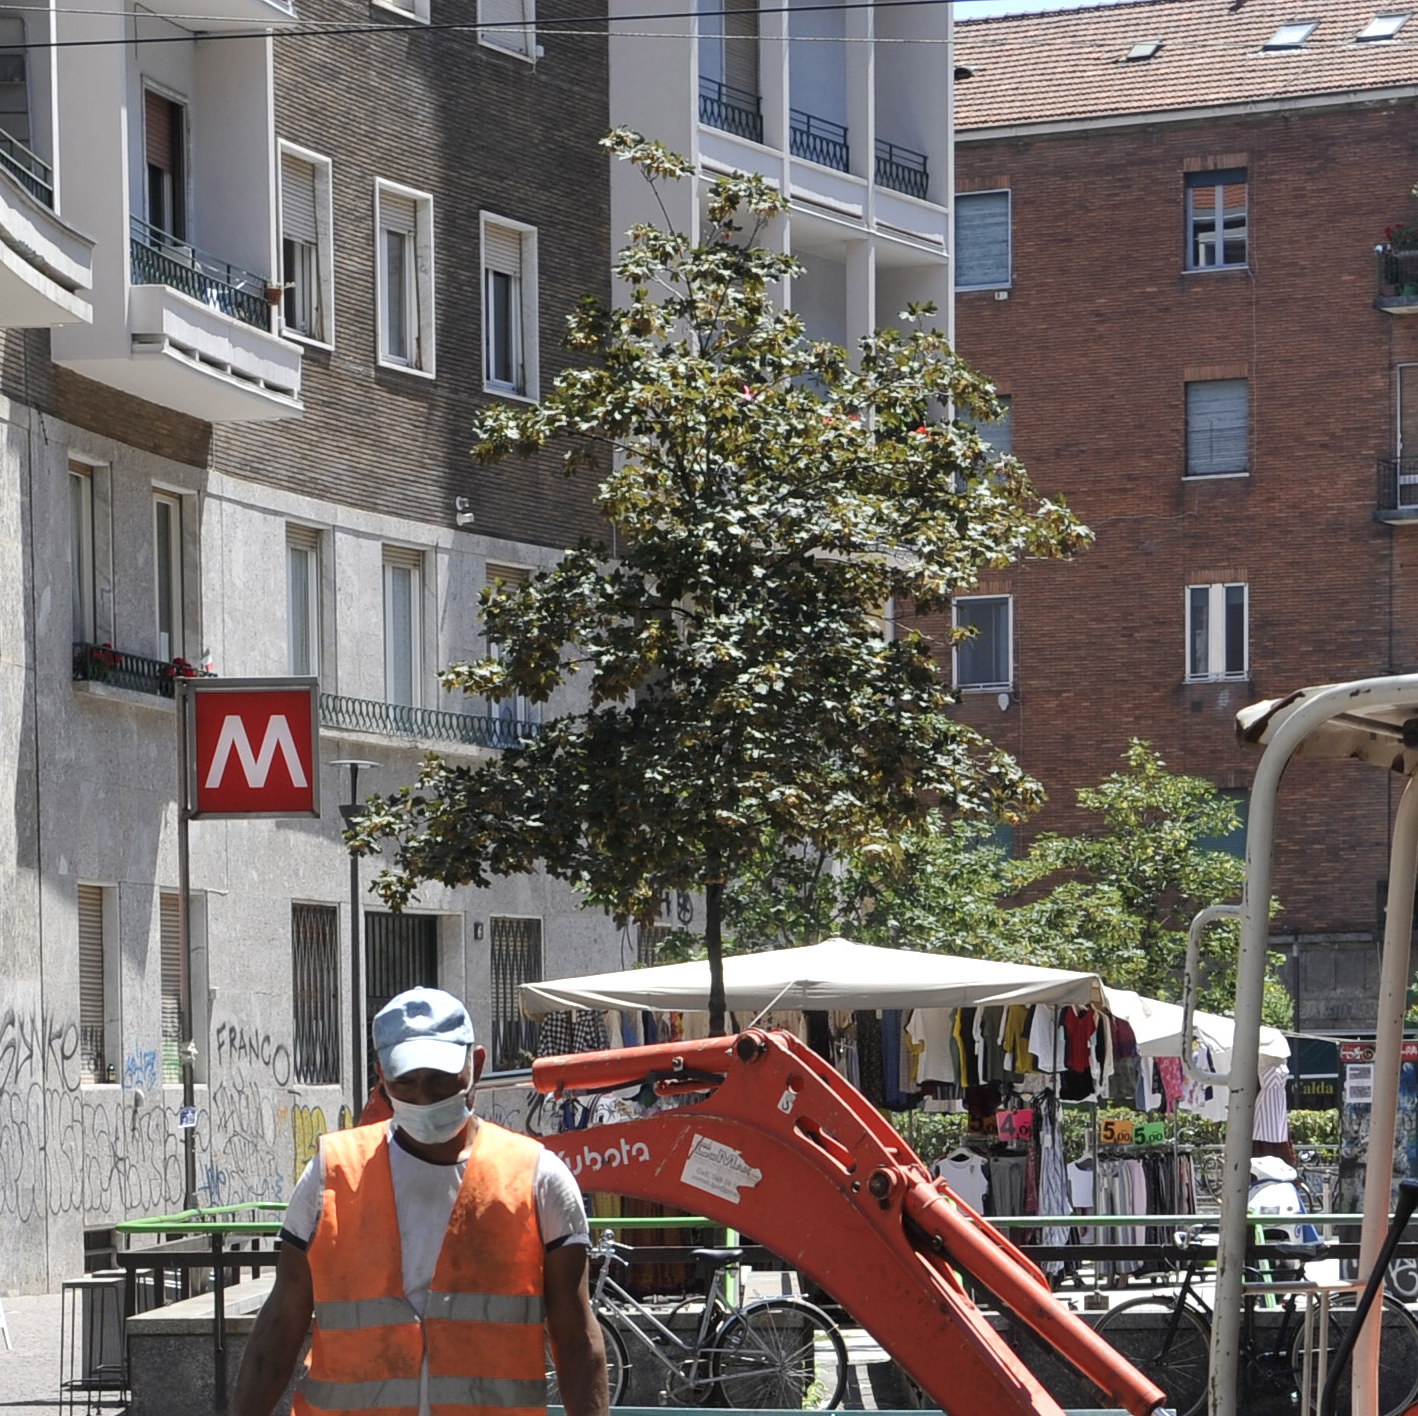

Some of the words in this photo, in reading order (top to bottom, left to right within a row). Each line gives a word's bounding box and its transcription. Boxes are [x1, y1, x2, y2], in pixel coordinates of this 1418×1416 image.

[204, 714, 309, 789] M
[216, 1021, 290, 1087] FRANCO
[558, 1137, 651, 1176] ubota
